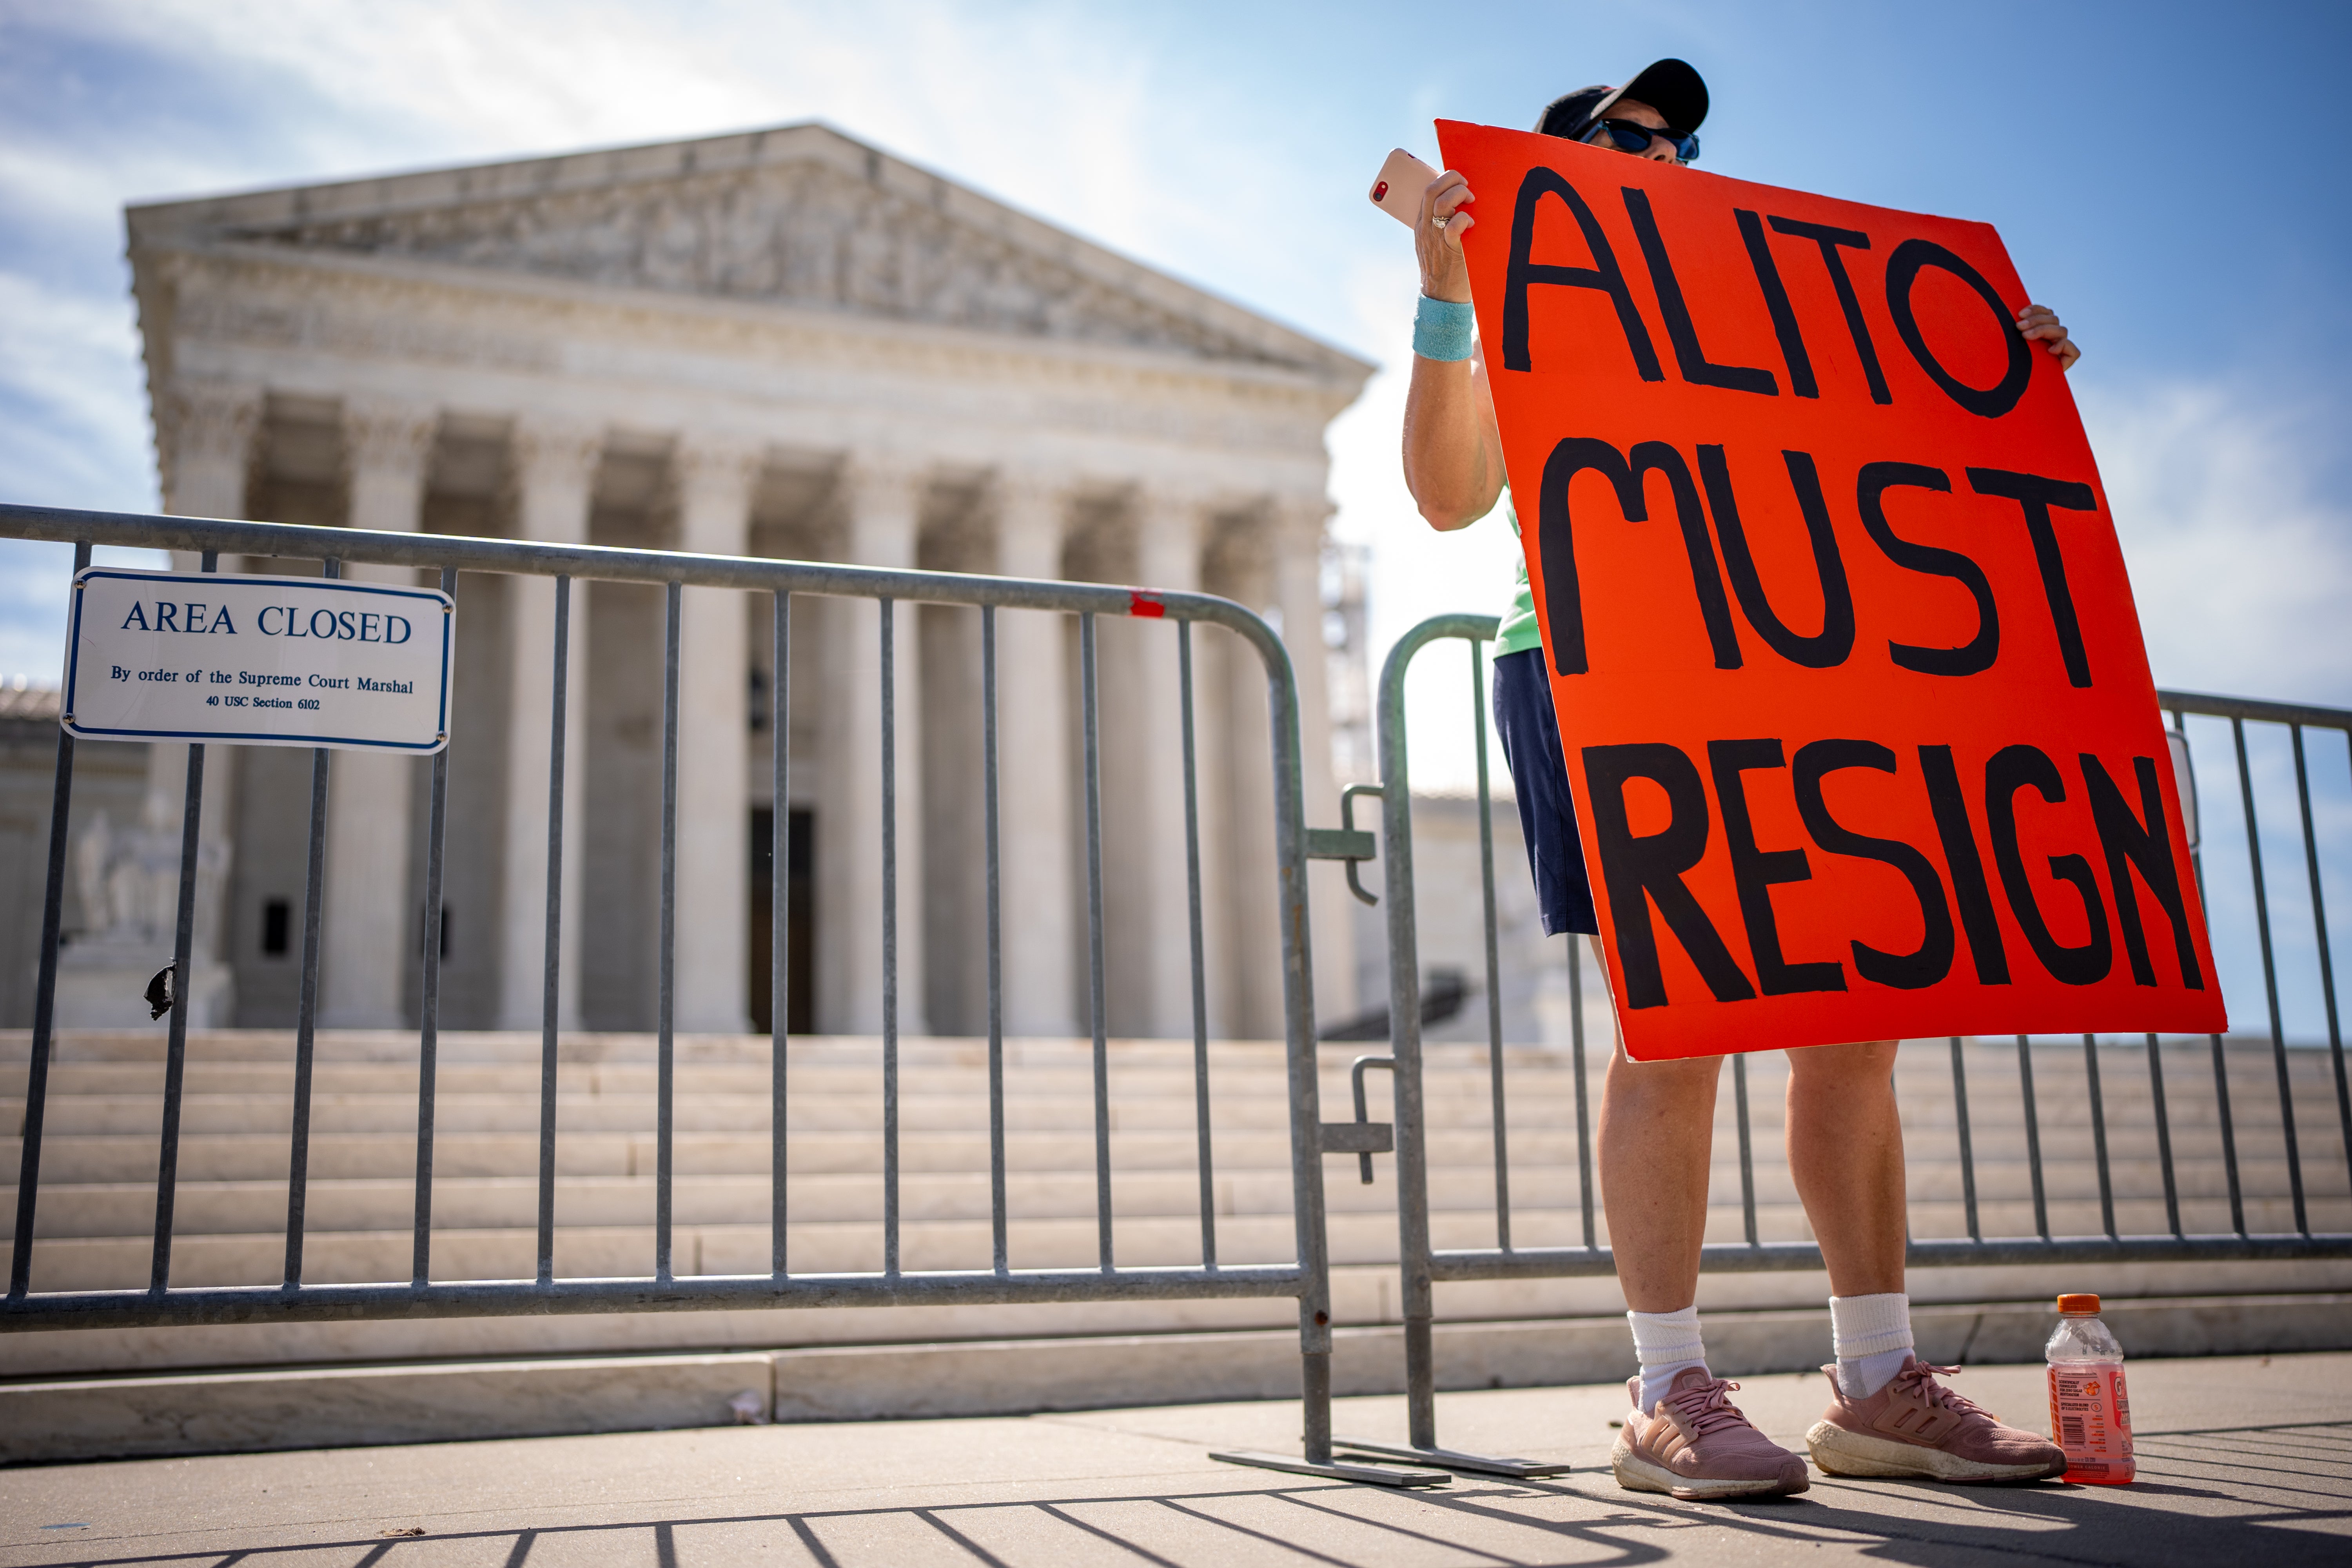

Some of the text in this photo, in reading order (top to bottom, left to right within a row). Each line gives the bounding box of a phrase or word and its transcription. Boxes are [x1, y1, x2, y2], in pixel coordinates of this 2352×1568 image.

[1502, 166, 2033, 419] ALITO
[120, 600, 412, 644] AREA CLOSED
[1539, 437, 2098, 688] MUST
[110, 665, 413, 693] By order of the Supreme Court Marshal
[206, 696, 320, 710] 40 USC Section 6102
[1582, 738, 2205, 1009] RESIGN
